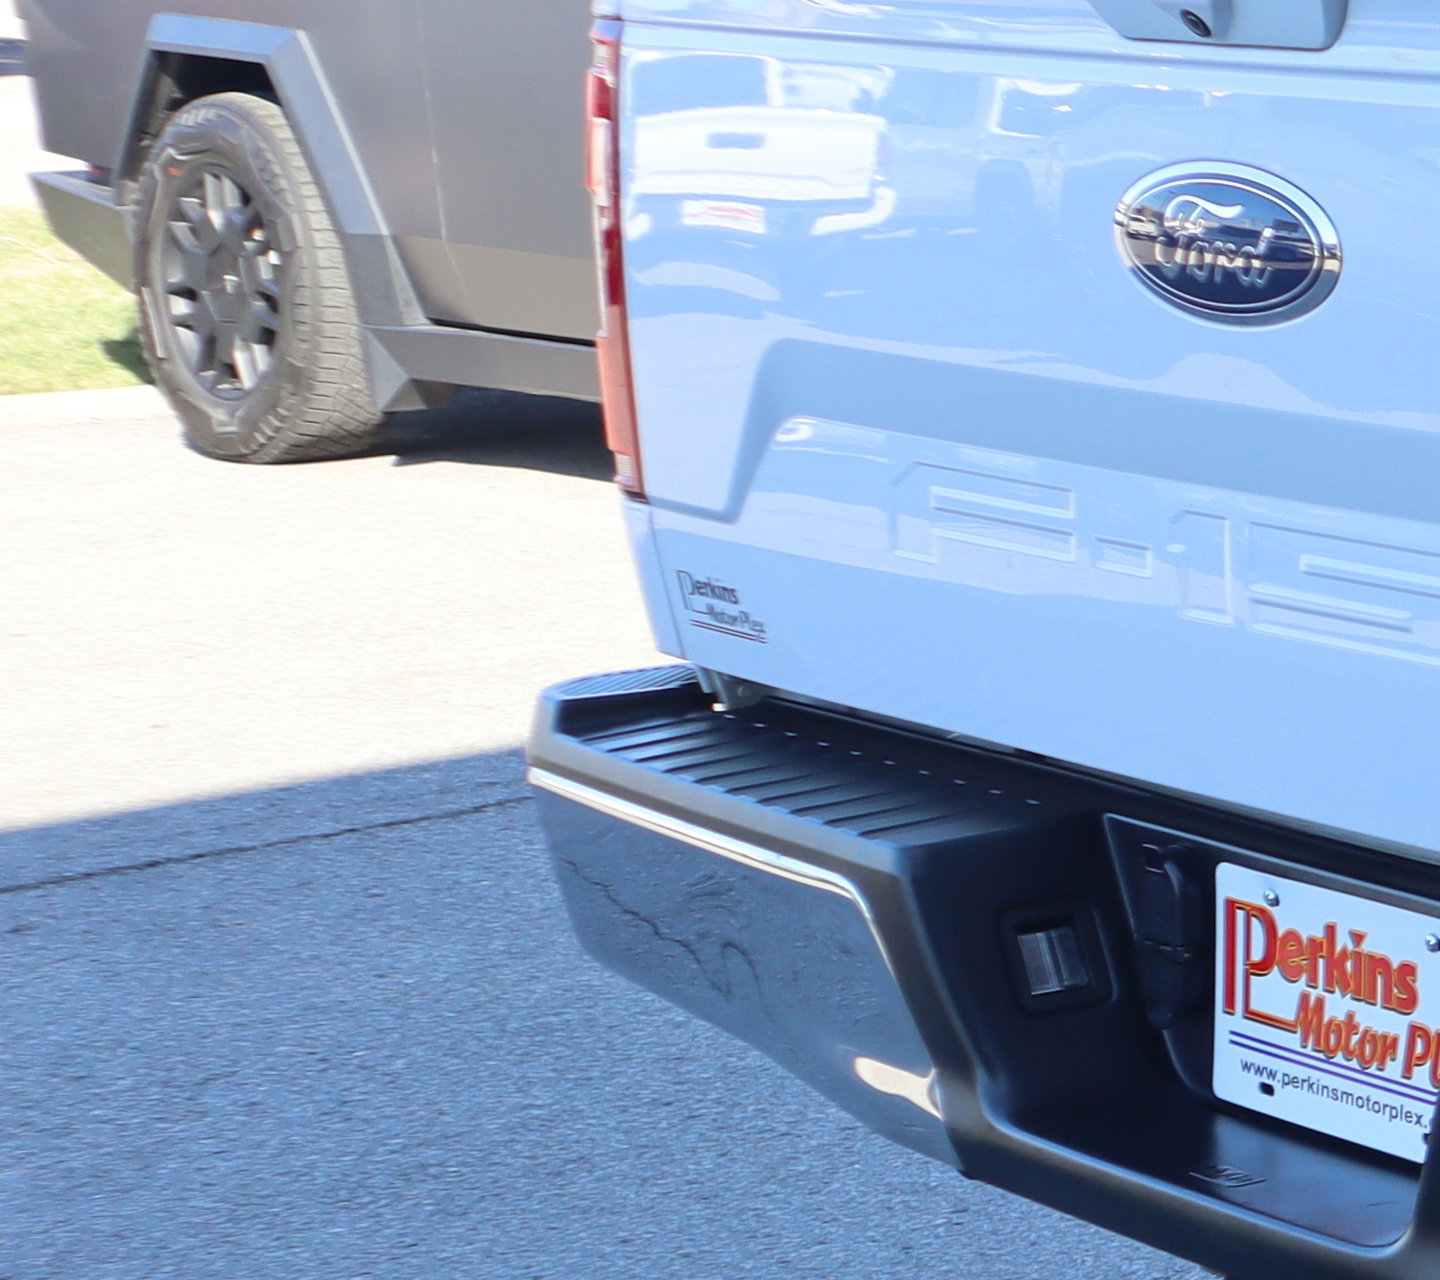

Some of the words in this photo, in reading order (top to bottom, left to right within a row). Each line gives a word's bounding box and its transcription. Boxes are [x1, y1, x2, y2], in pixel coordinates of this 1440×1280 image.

[1154, 194, 1273, 288] Ford
[1222, 896, 1420, 1031] Perkins
[1297, 990, 1400, 1071] Motor
[1240, 1058, 1433, 1131] www.perkinsmotorplex.
